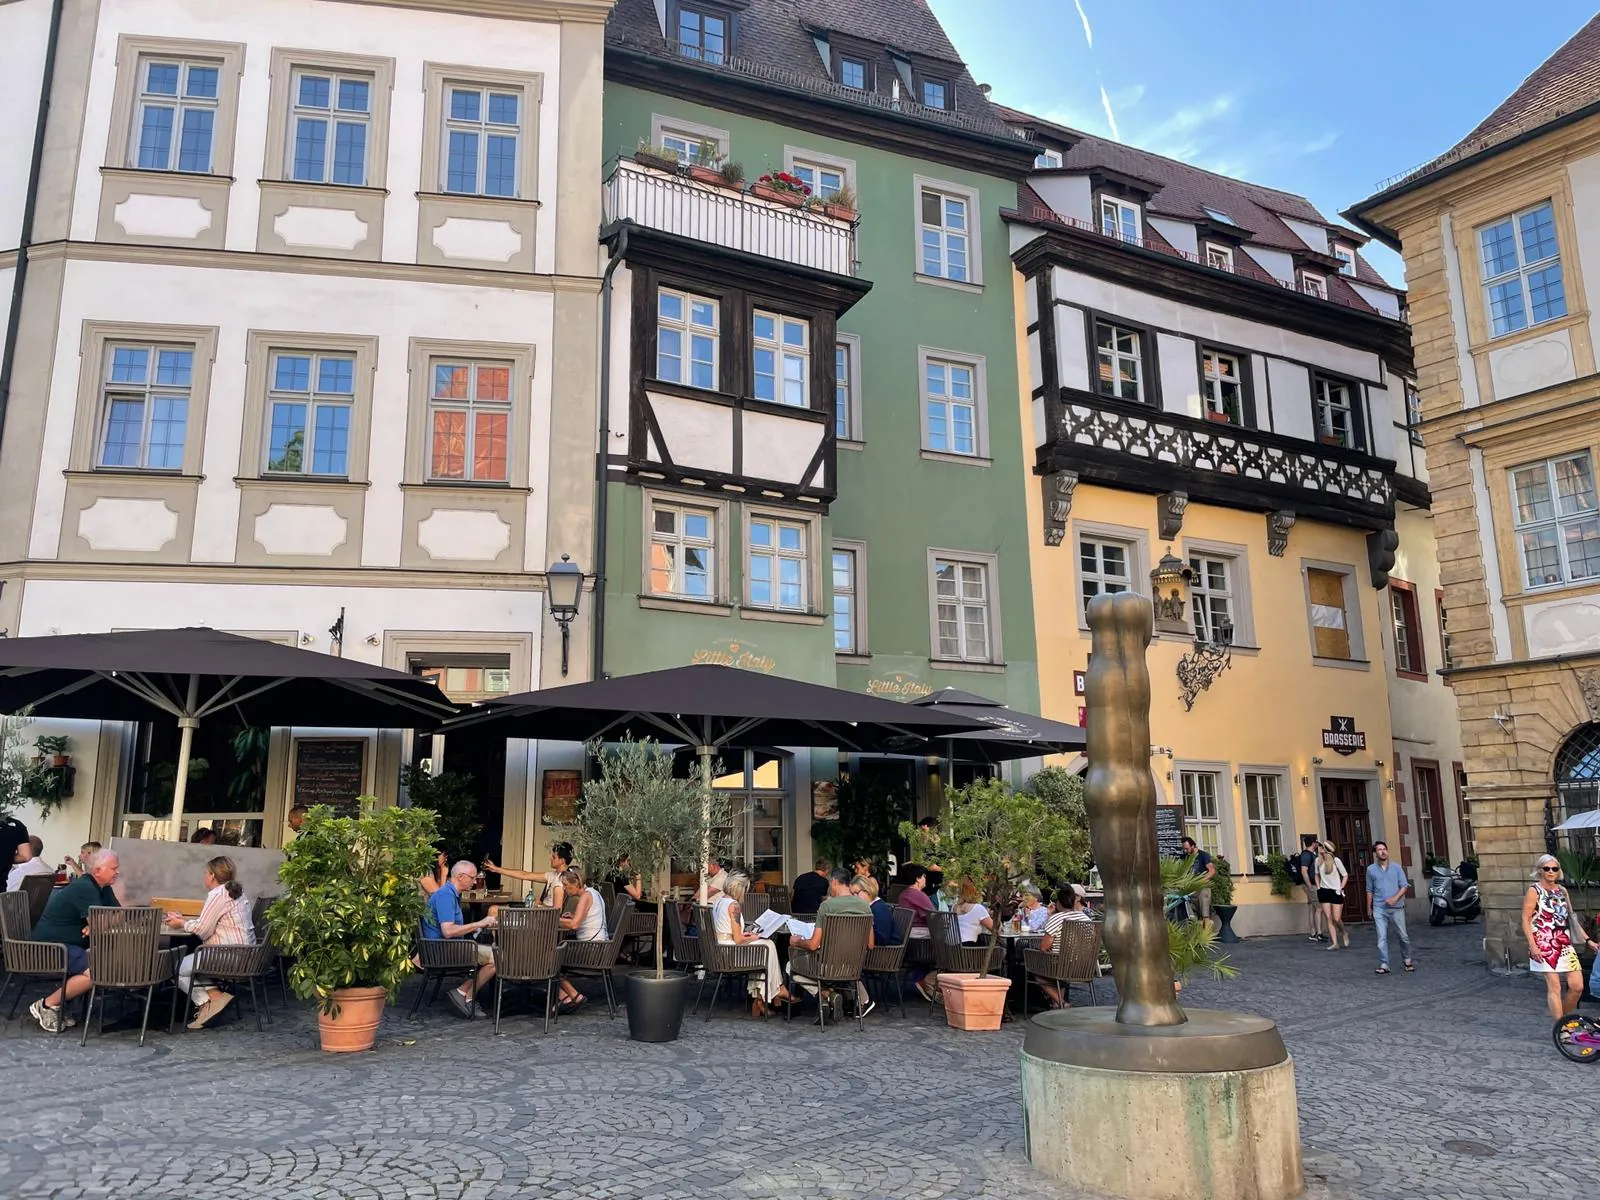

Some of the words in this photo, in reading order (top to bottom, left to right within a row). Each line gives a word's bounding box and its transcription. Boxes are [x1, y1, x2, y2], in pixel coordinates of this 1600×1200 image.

[692, 648, 734, 666] Little
[736, 651, 776, 674] Italy
[866, 679, 900, 697] Little
[901, 681, 934, 697] Italy
[1076, 675, 1085, 692] B
[1323, 732, 1365, 747] BRASSERIE
